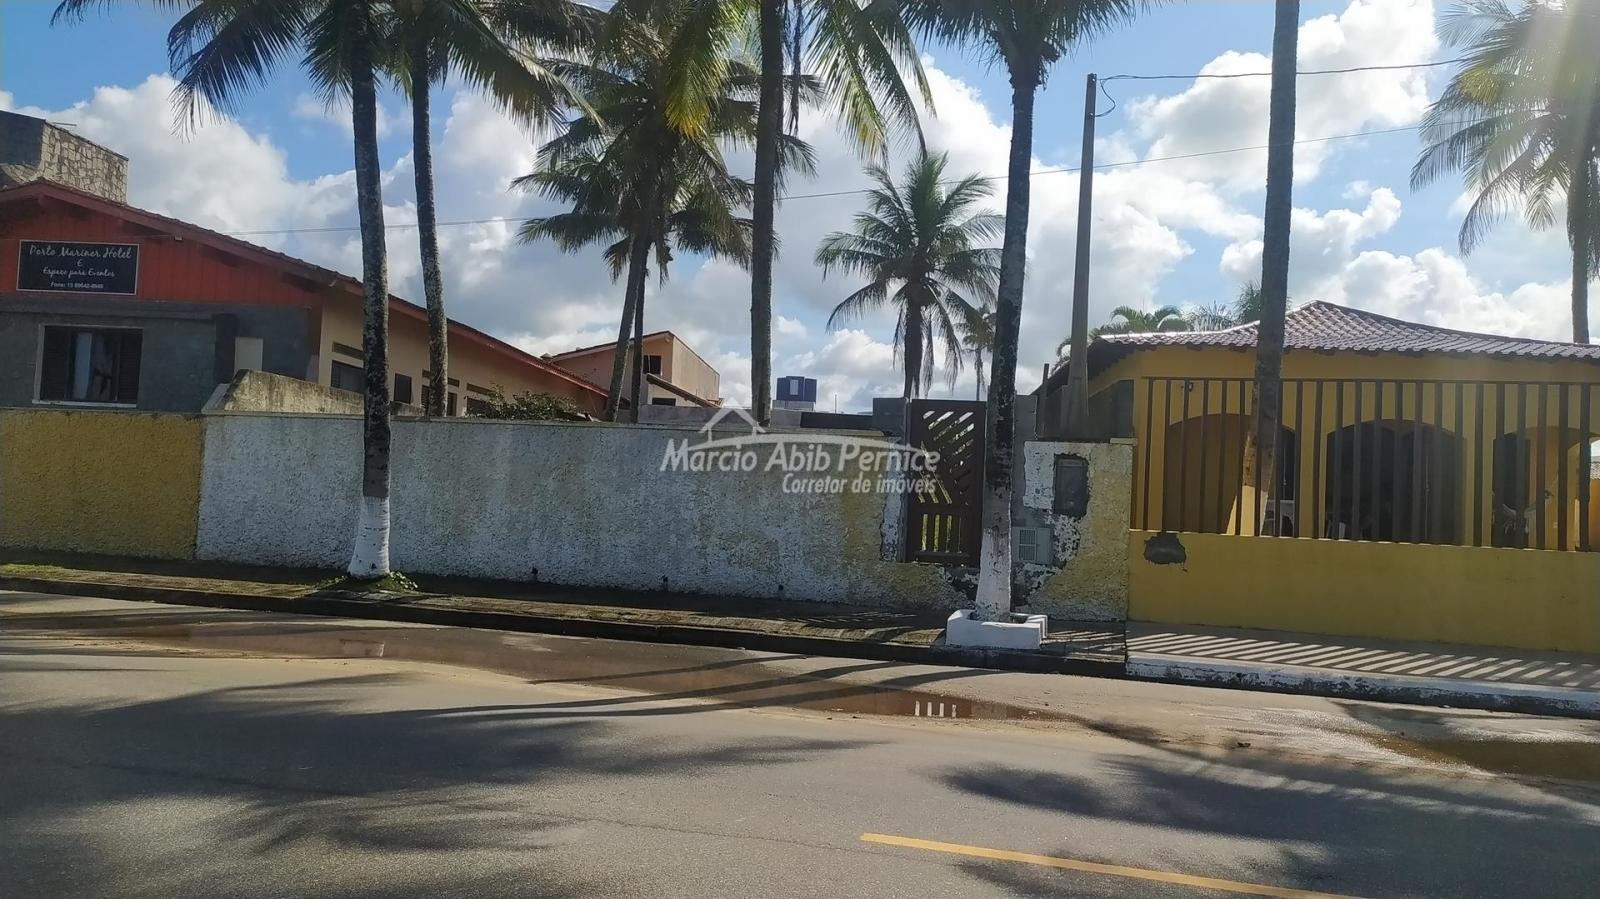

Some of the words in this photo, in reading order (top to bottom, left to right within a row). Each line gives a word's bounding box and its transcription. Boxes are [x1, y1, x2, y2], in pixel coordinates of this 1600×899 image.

[29, 244, 55, 256] Porto
[59, 247, 101, 258] Mariner
[103, 247, 132, 259] Hotel
[68, 270, 86, 278] para
[88, 268, 115, 277] Eventos
